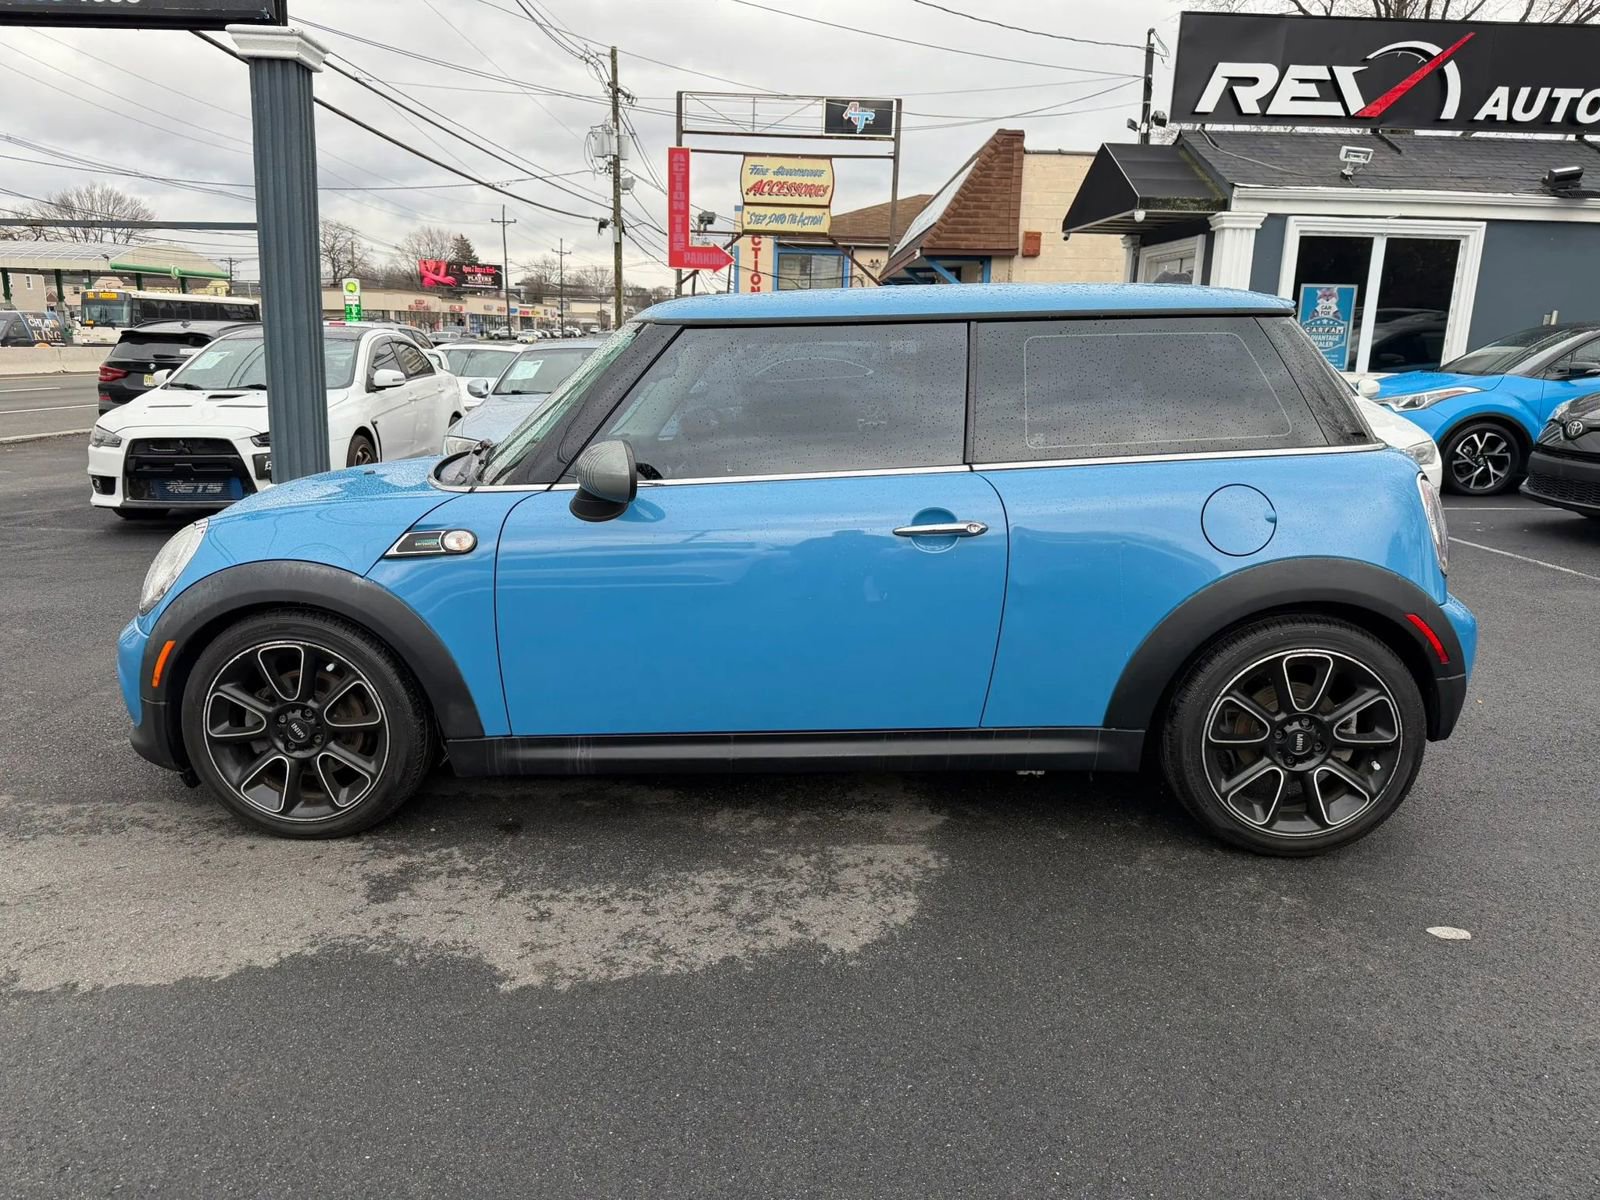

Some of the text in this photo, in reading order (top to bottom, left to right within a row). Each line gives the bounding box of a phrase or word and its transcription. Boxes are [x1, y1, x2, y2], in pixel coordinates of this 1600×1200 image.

[1194, 32, 1476, 119] REV
[745, 179, 830, 198] ACCESSORIES
[672, 153, 686, 251] ACTION TIRE
[683, 252, 727, 265] PARKING
[33, 330, 62, 341] KING
